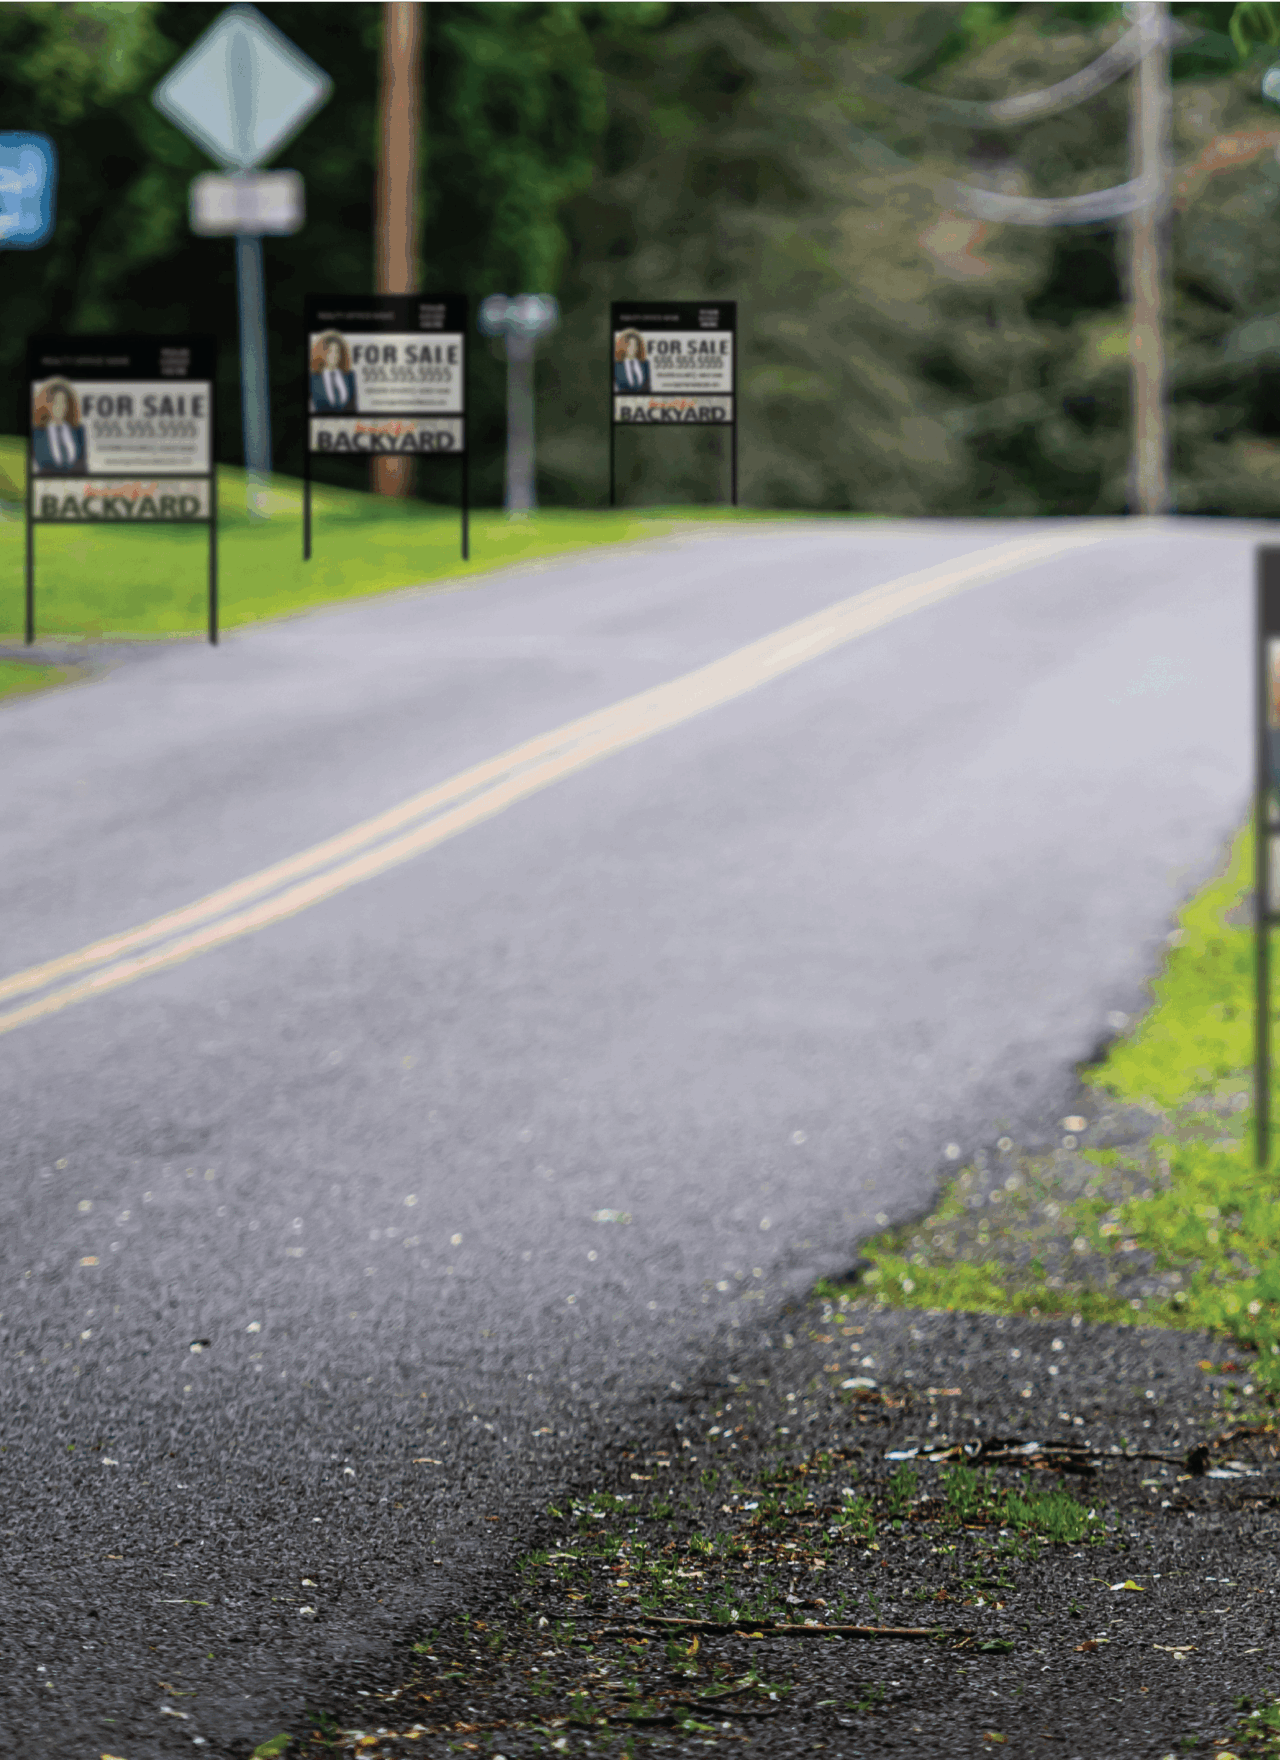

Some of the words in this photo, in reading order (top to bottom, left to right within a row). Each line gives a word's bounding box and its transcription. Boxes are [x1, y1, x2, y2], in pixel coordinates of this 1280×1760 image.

[352, 344, 398, 365] FOR
[405, 344, 458, 365] SALE
[647, 340, 682, 355] FOR
[687, 340, 728, 355] SALE
[82, 394, 134, 418] FOR
[143, 394, 205, 418] SALE
[620, 406, 726, 422] BACKYARD
[317, 430, 455, 452] BACKYARD
[40, 493, 201, 518] BACKYARD
